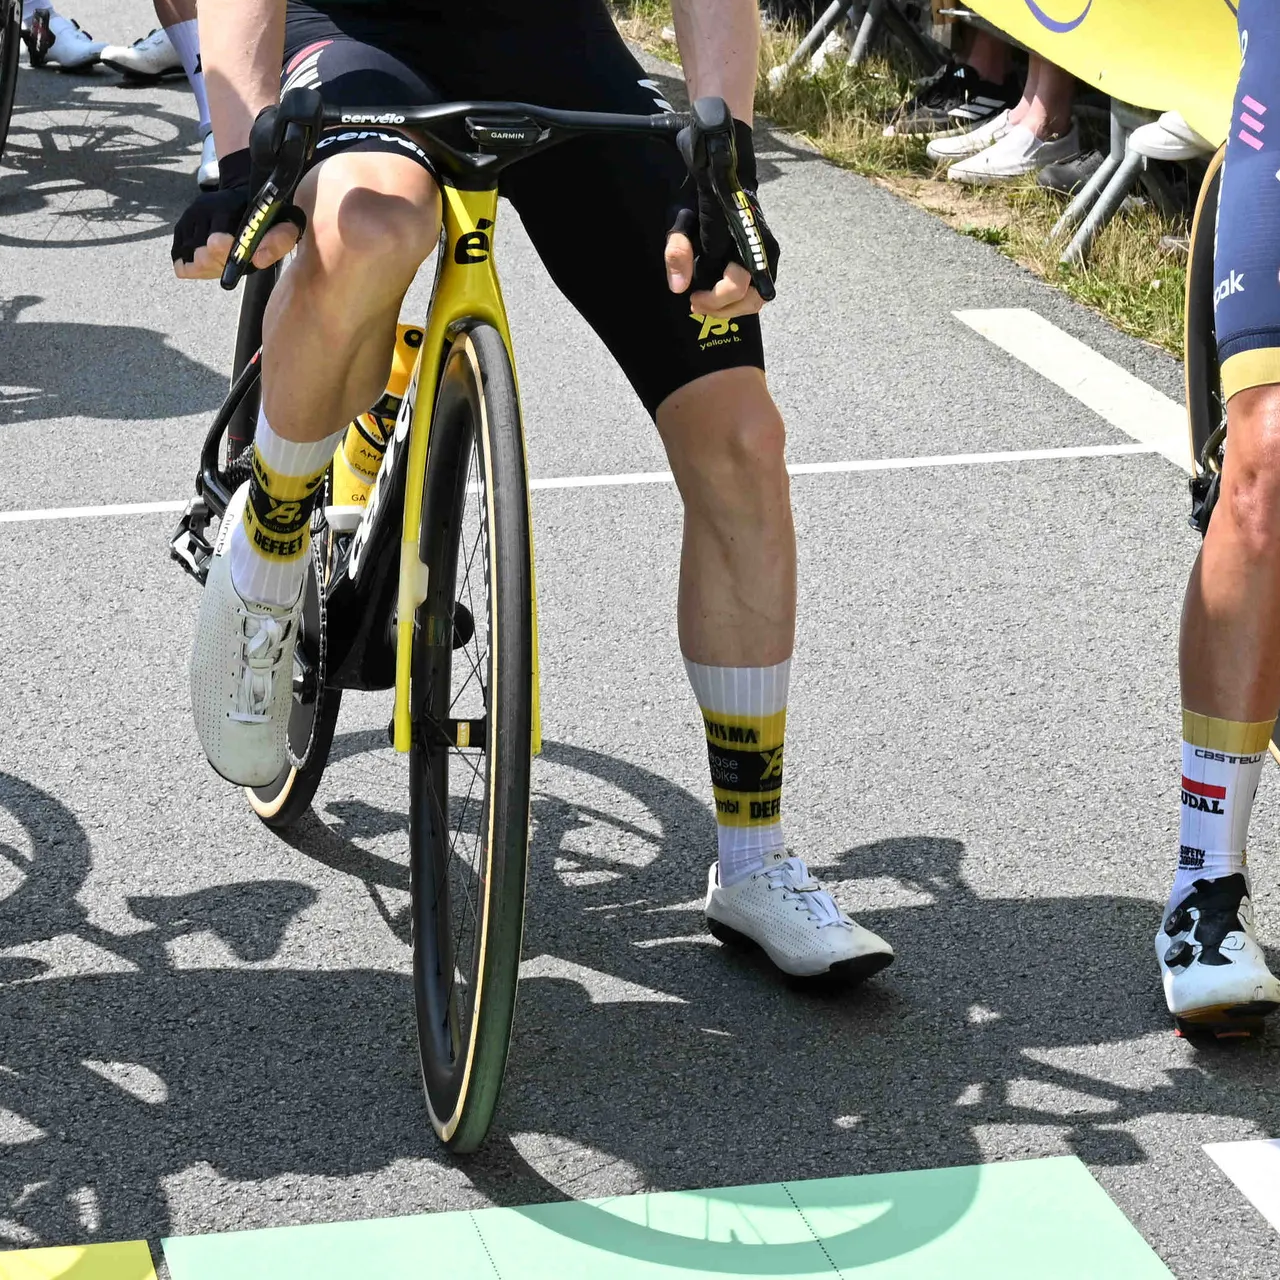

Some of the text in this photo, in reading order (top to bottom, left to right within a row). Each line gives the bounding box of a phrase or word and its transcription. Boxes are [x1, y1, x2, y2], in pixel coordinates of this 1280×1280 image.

[491, 132, 525, 140] GARMIN
[732, 190, 767, 271] SRAM
[699, 337, 731, 351] yellow
[253, 528, 303, 557] DEFEET
